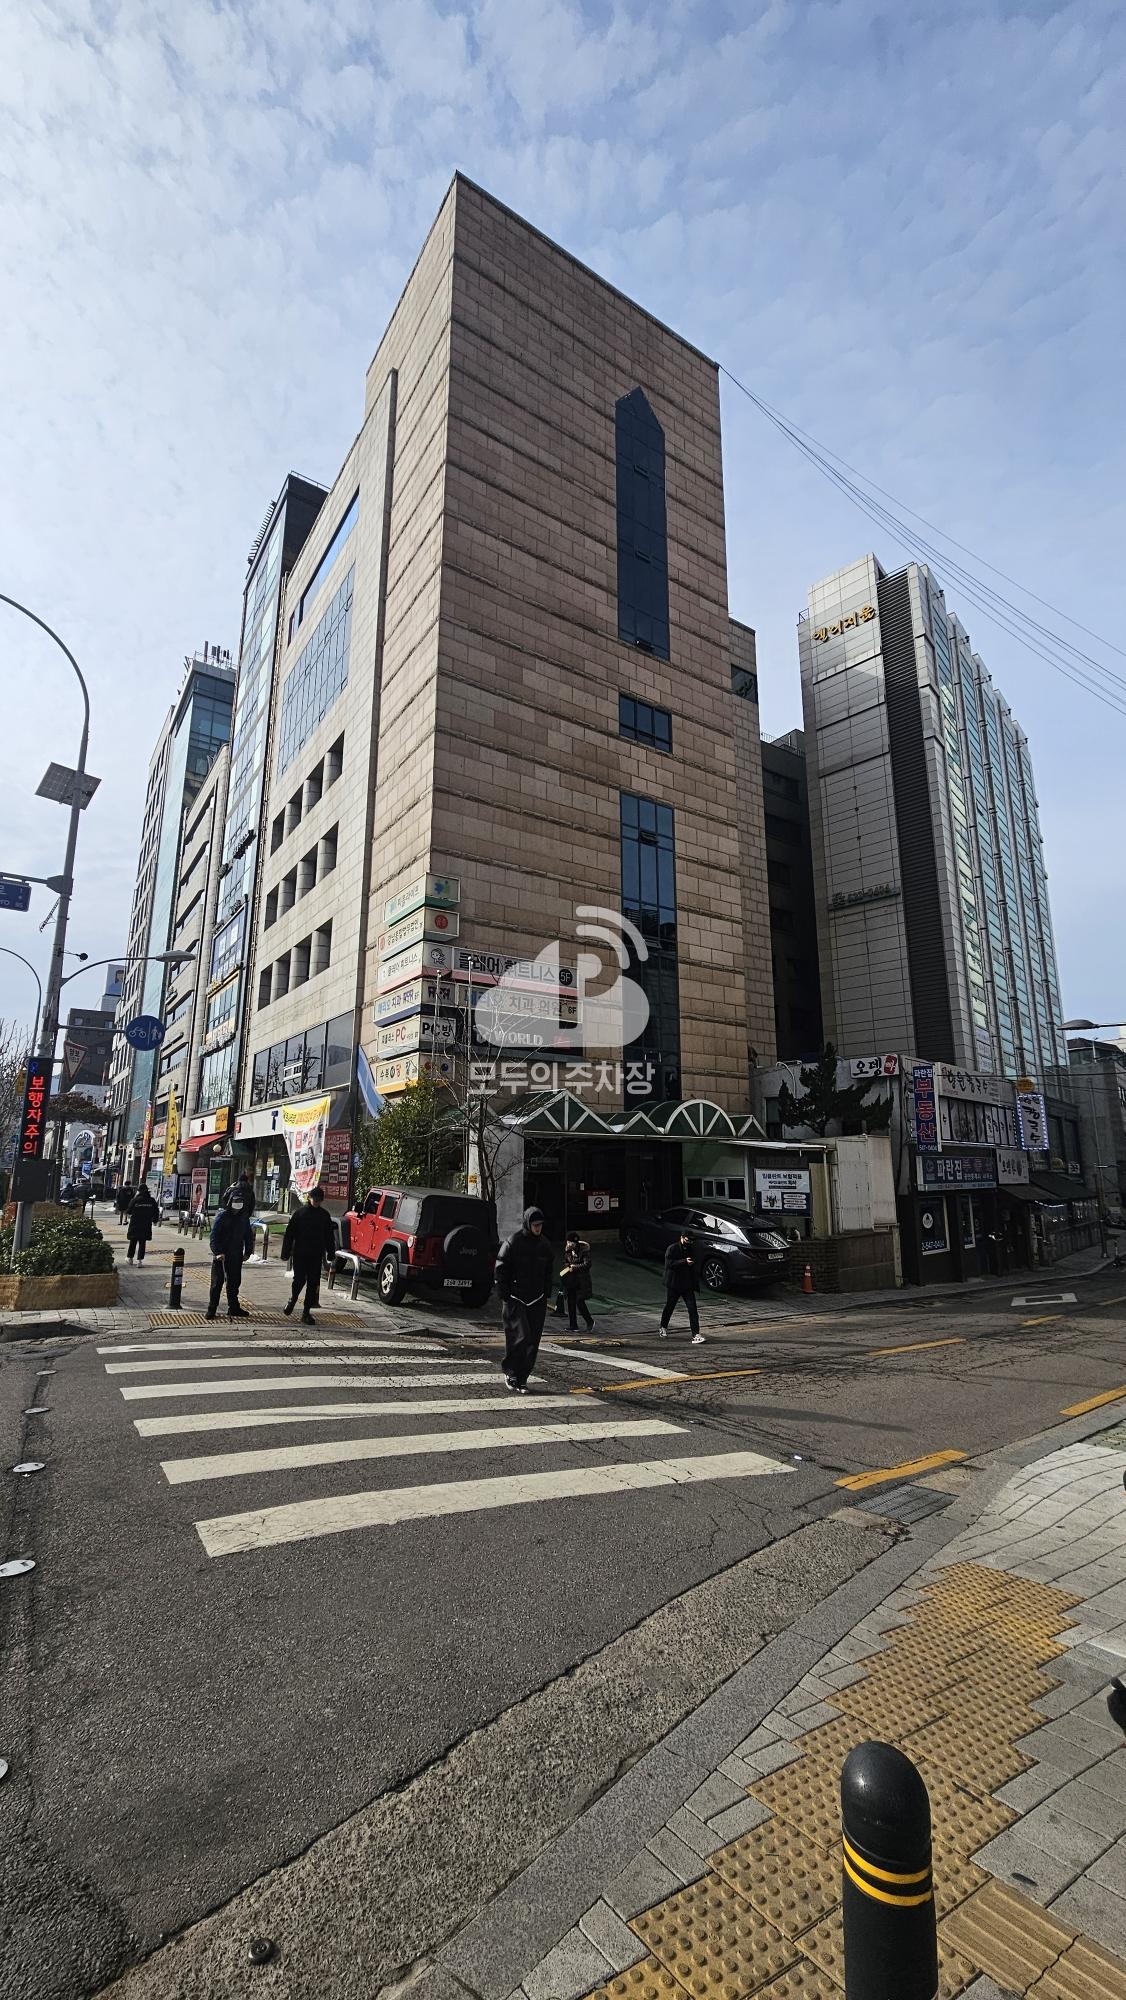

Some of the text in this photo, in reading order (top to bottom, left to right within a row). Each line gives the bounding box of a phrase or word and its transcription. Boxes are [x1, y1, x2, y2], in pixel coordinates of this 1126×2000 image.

[560, 970, 572, 982] 5F
[510, 995, 534, 1013] 치과
[395, 1026, 406, 1042] PC
[914, 1068, 933, 1078] 파란집
[22, 1076, 45, 1156] 보행자주의
[915, 1079, 936, 1142] 부동산
[937, 1159, 963, 1180] 파란집
